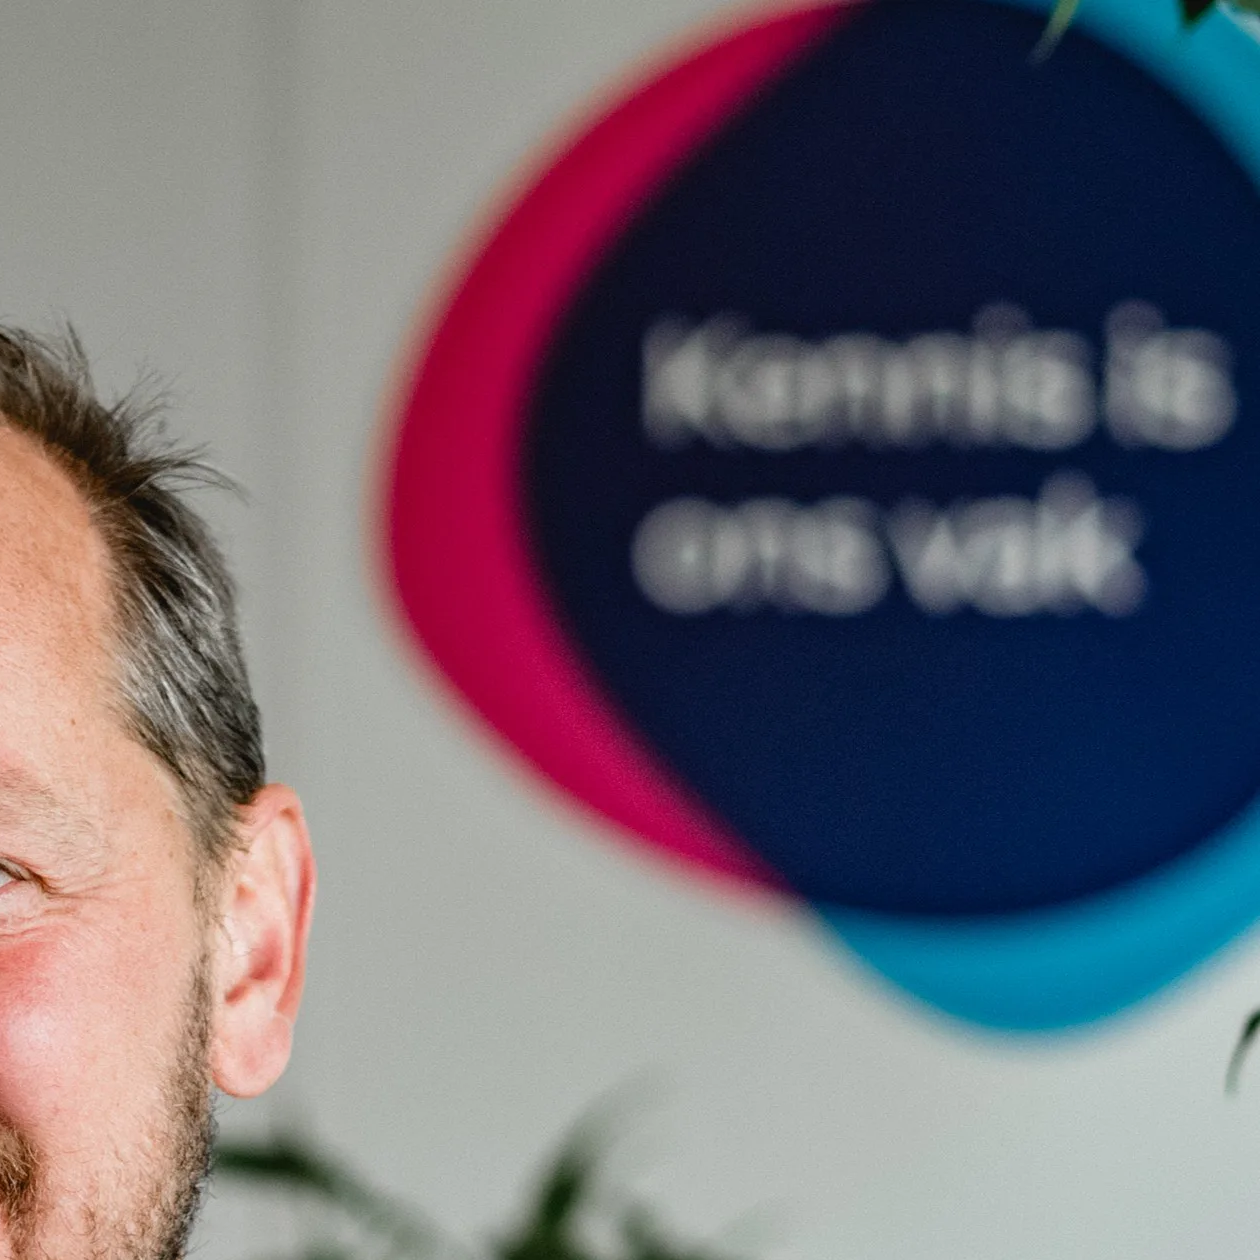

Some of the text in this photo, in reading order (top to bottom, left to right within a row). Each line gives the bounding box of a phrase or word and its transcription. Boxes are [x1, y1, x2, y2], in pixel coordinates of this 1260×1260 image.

[644, 304, 1232, 447] Kennis is
[634, 498, 886, 614] ons
